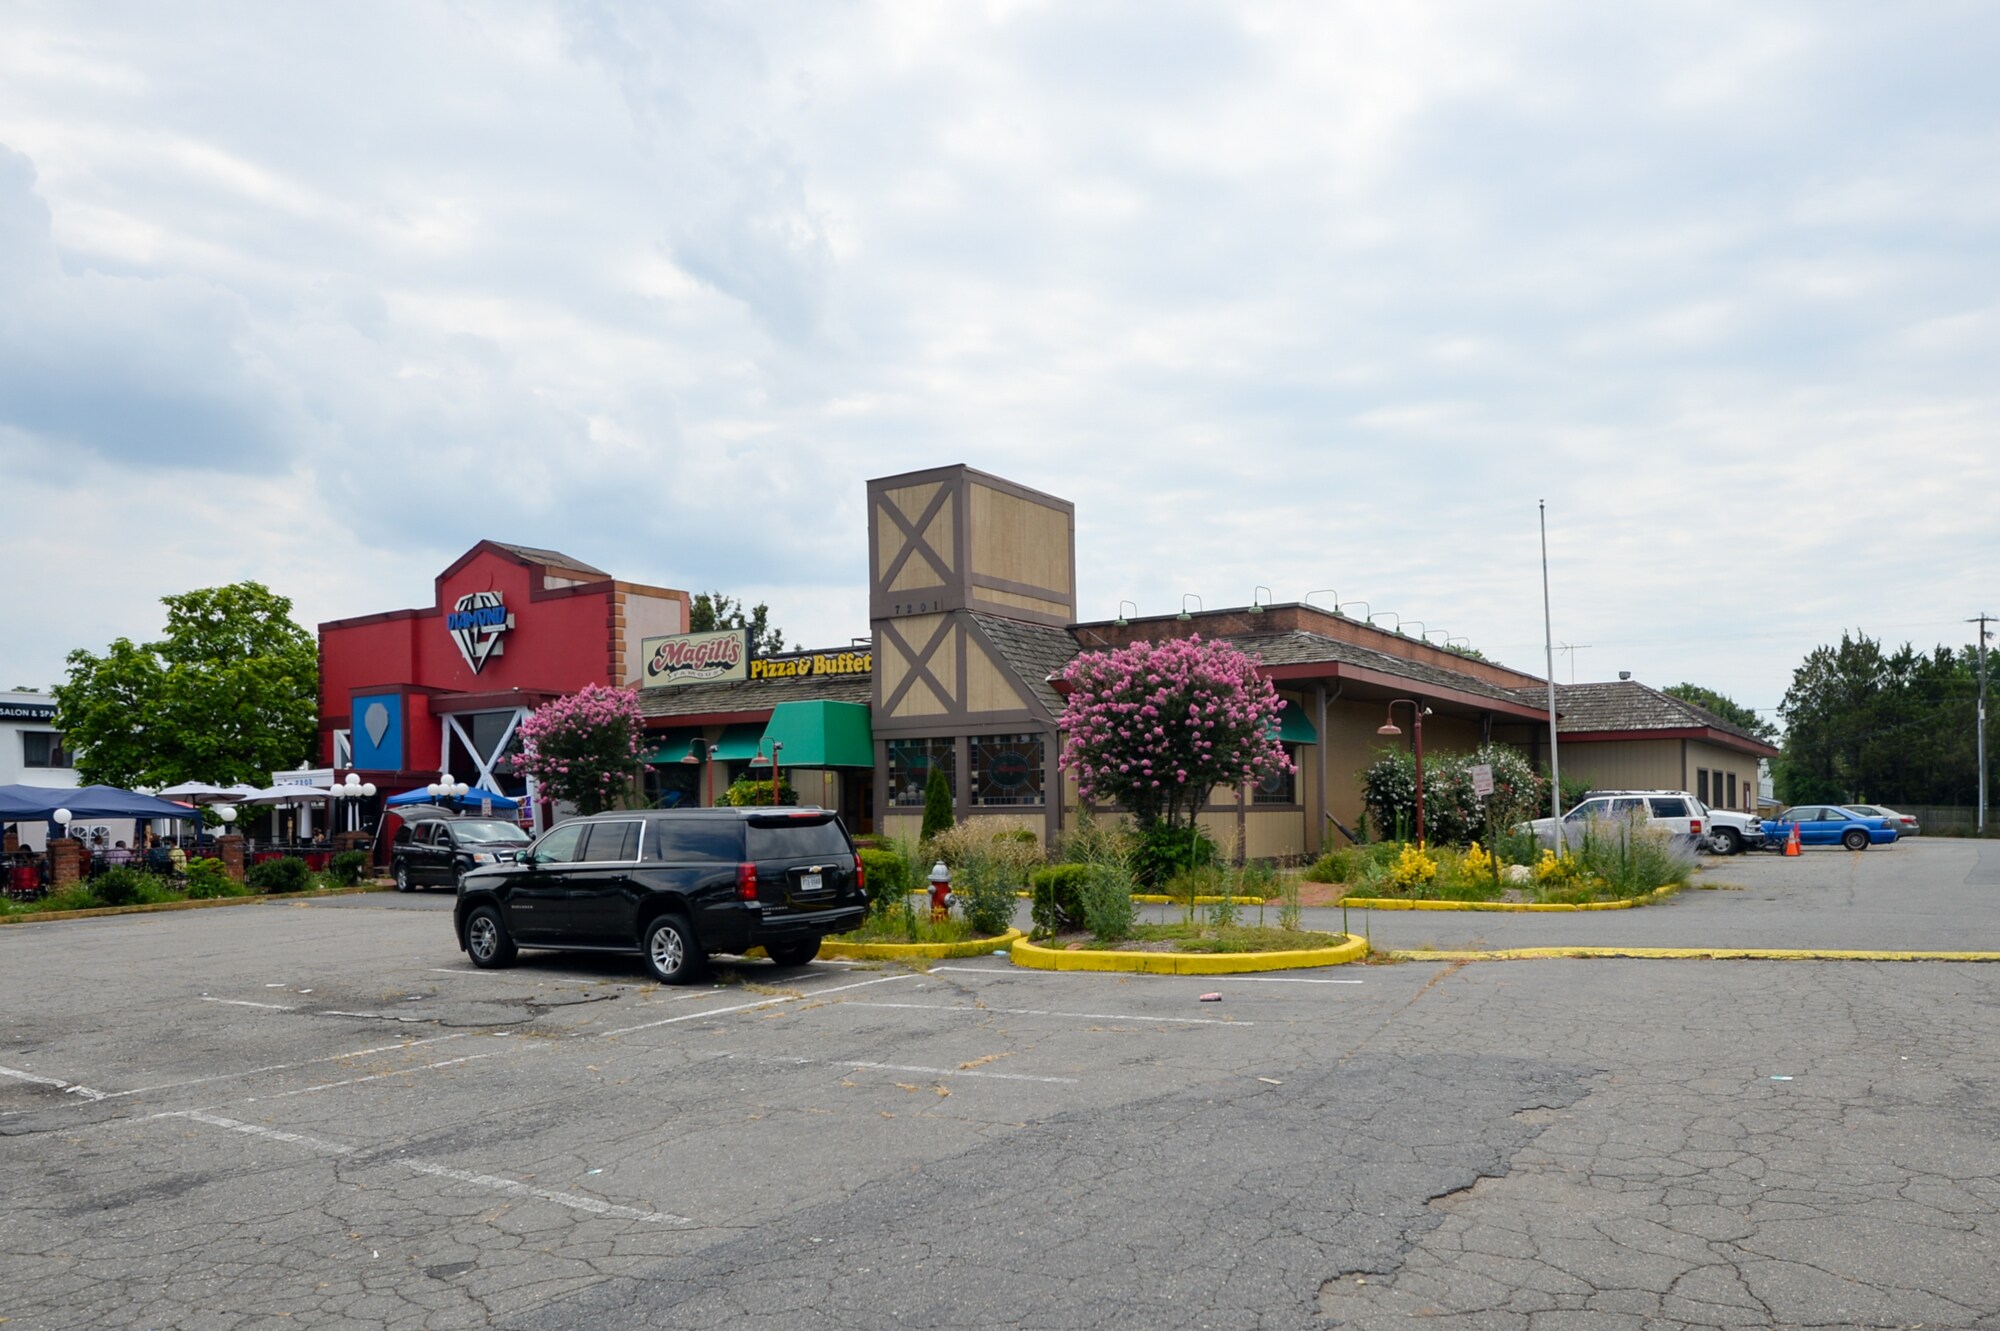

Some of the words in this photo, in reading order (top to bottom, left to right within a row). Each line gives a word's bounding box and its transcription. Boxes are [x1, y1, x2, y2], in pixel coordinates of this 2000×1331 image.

[447, 606, 506, 631] DIAMOND
[673, 669, 720, 678] FAMOUS
[750, 659, 797, 679] Pizza
[797, 658, 811, 676] &
[812, 653, 873, 675] Buffet
[0, 708, 29, 716] SALON
[31, 709, 38, 717] &
[40, 710, 56, 718] SPA
